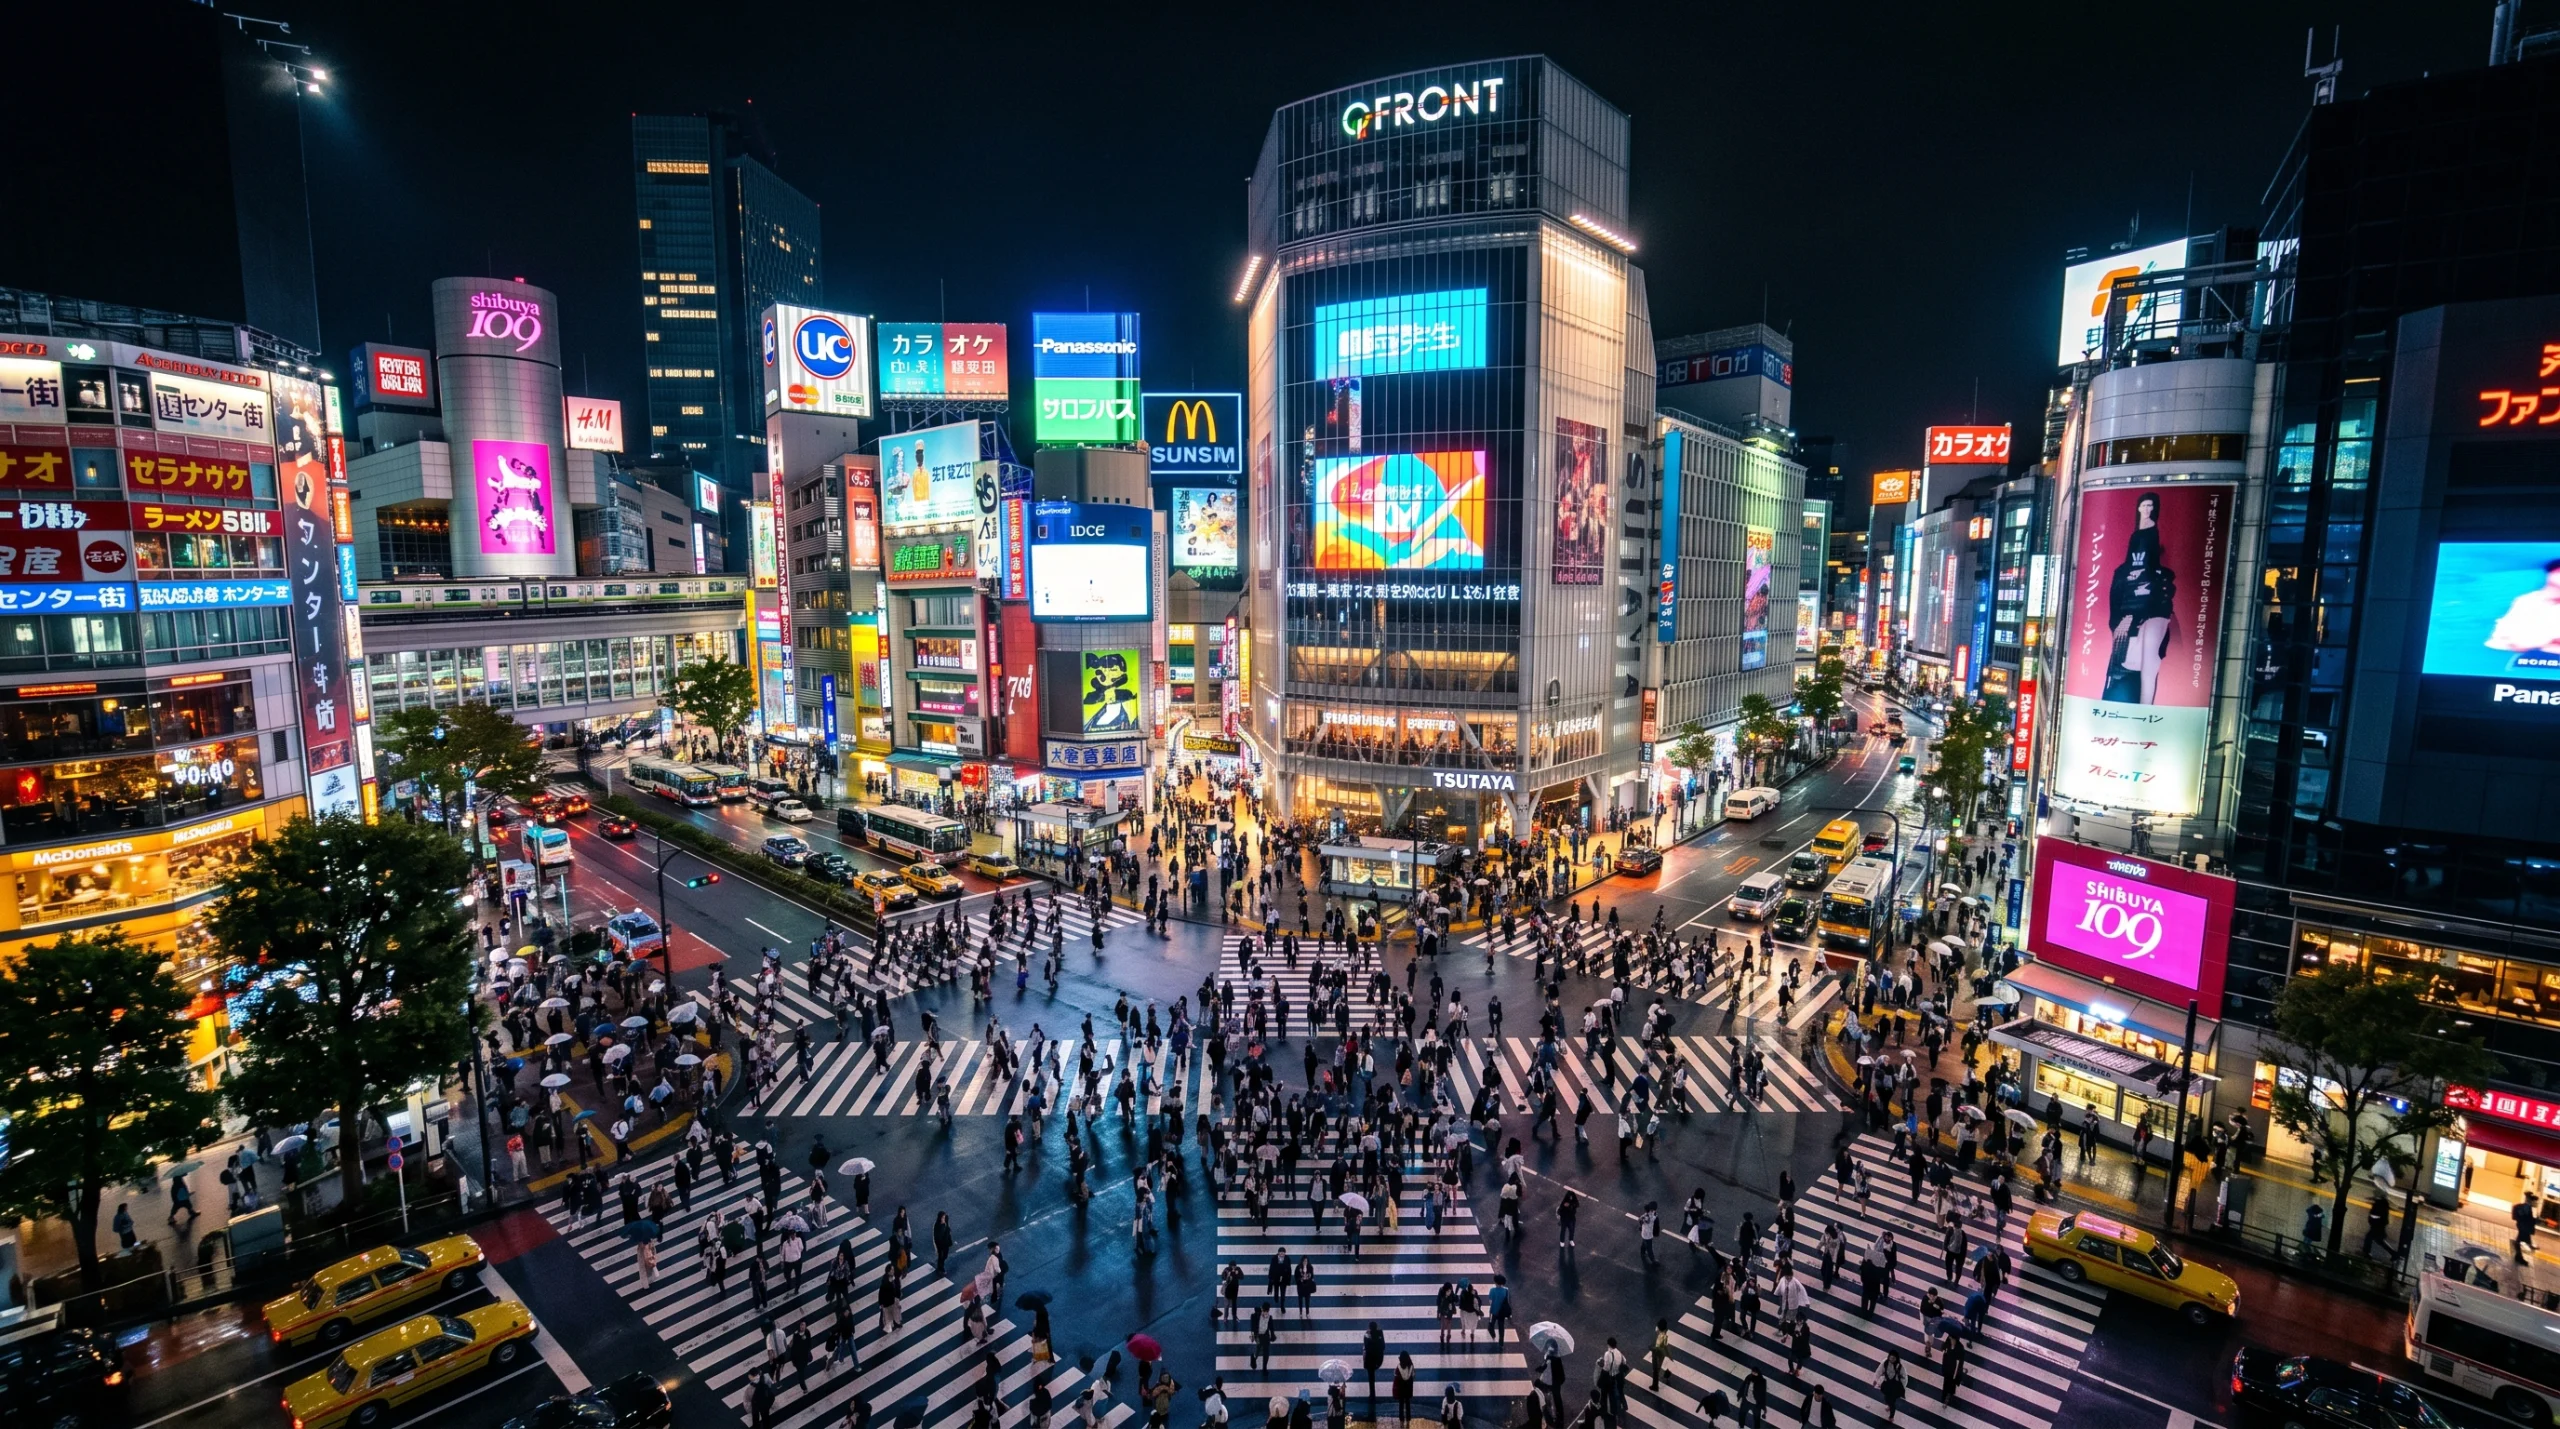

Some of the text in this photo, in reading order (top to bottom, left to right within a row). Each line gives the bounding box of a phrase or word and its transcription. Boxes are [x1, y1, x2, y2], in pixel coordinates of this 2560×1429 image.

[471, 292, 541, 317] shibuya
[466, 310, 542, 352] 109
[2493, 683, 2560, 706] Pana
[1433, 772, 1515, 791] TSUTAYA
[2085, 880, 2165, 917] SHIBUYA
[2075, 898, 2163, 960] 109
